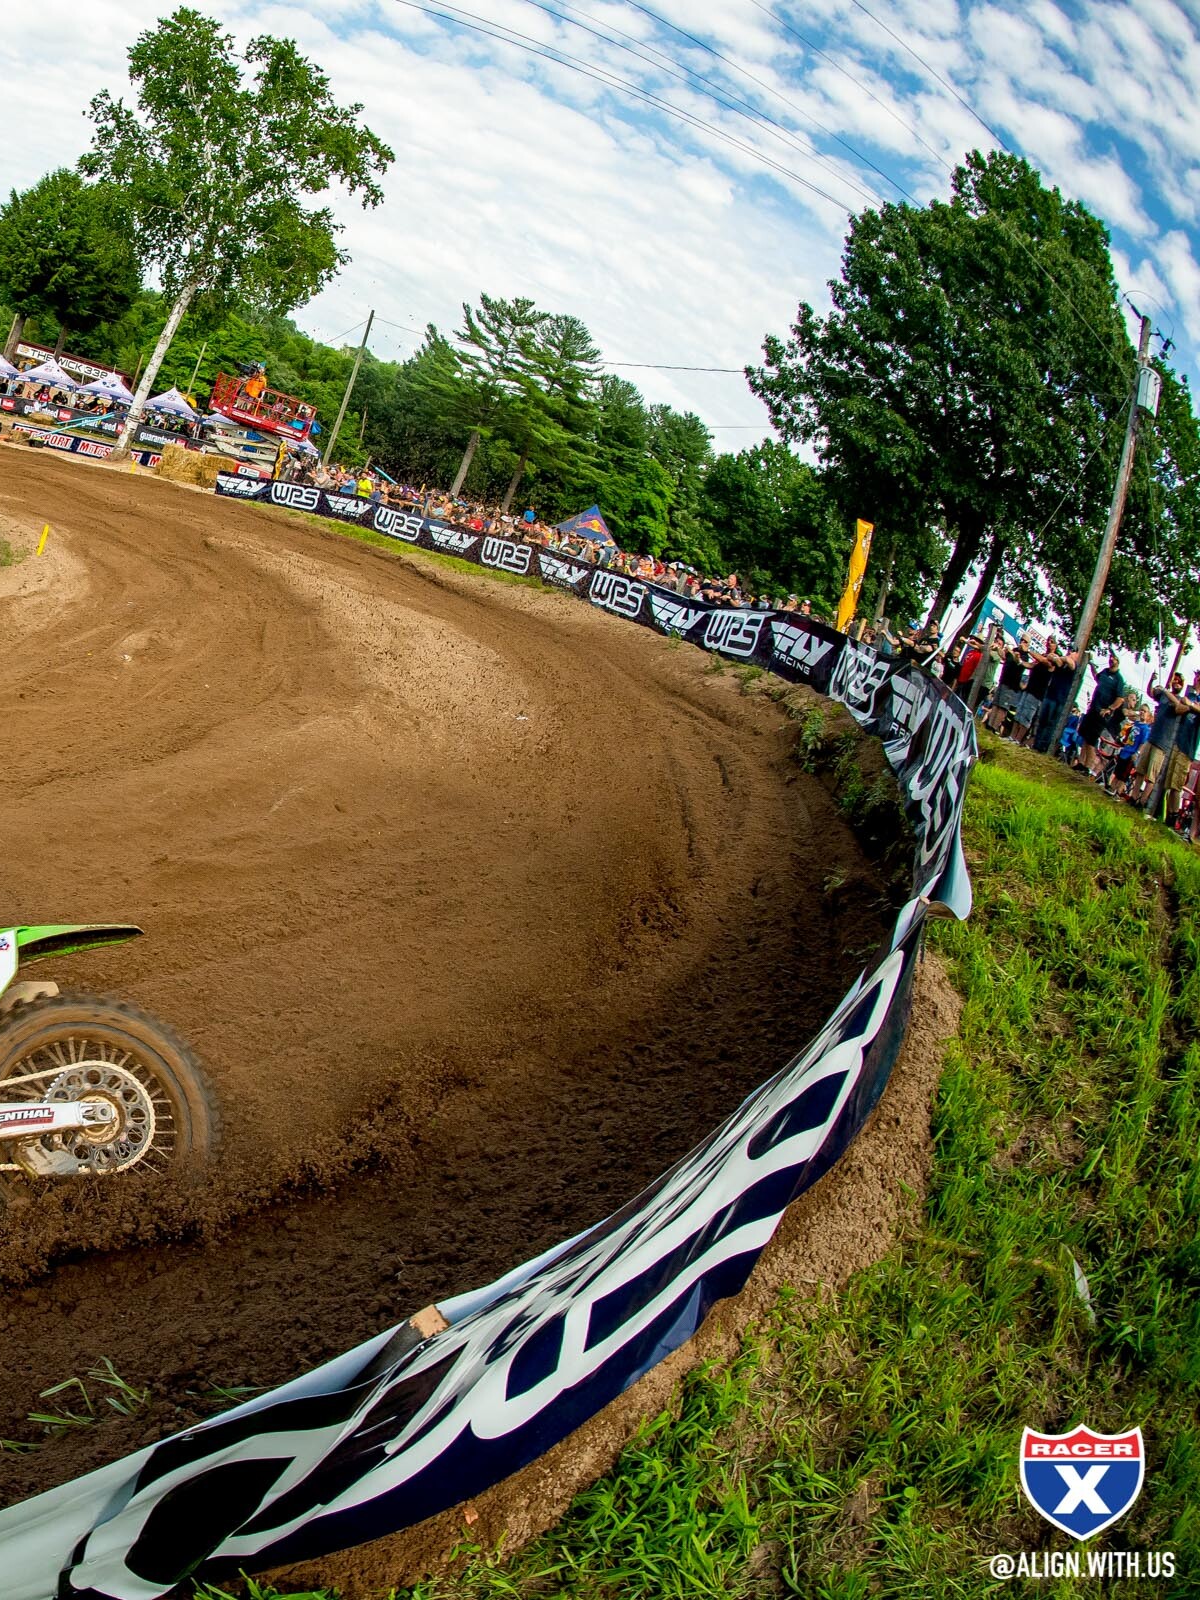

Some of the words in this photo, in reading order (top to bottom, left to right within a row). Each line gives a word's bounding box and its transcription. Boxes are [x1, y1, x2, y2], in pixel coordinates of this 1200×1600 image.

[31, 349, 54, 363] THE
[57, 358, 83, 373] WICK
[215, 474, 267, 493] FLY
[222, 487, 254, 496] RACING
[271, 482, 321, 511] WPS
[325, 494, 373, 515] FLY
[332, 508, 361, 518] RACING
[374, 505, 424, 541] WPS
[428, 525, 479, 549] FLY
[434, 541, 464, 553] RACING
[480, 536, 532, 575] WPS
[538, 553, 589, 584] FLY
[543, 573, 571, 588] RACING
[589, 569, 648, 618] WPS
[651, 594, 707, 630] FLY
[654, 618, 687, 636] RACING
[703, 608, 766, 657] WPS
[771, 621, 834, 667] FLY
[773, 649, 811, 676] RACING
